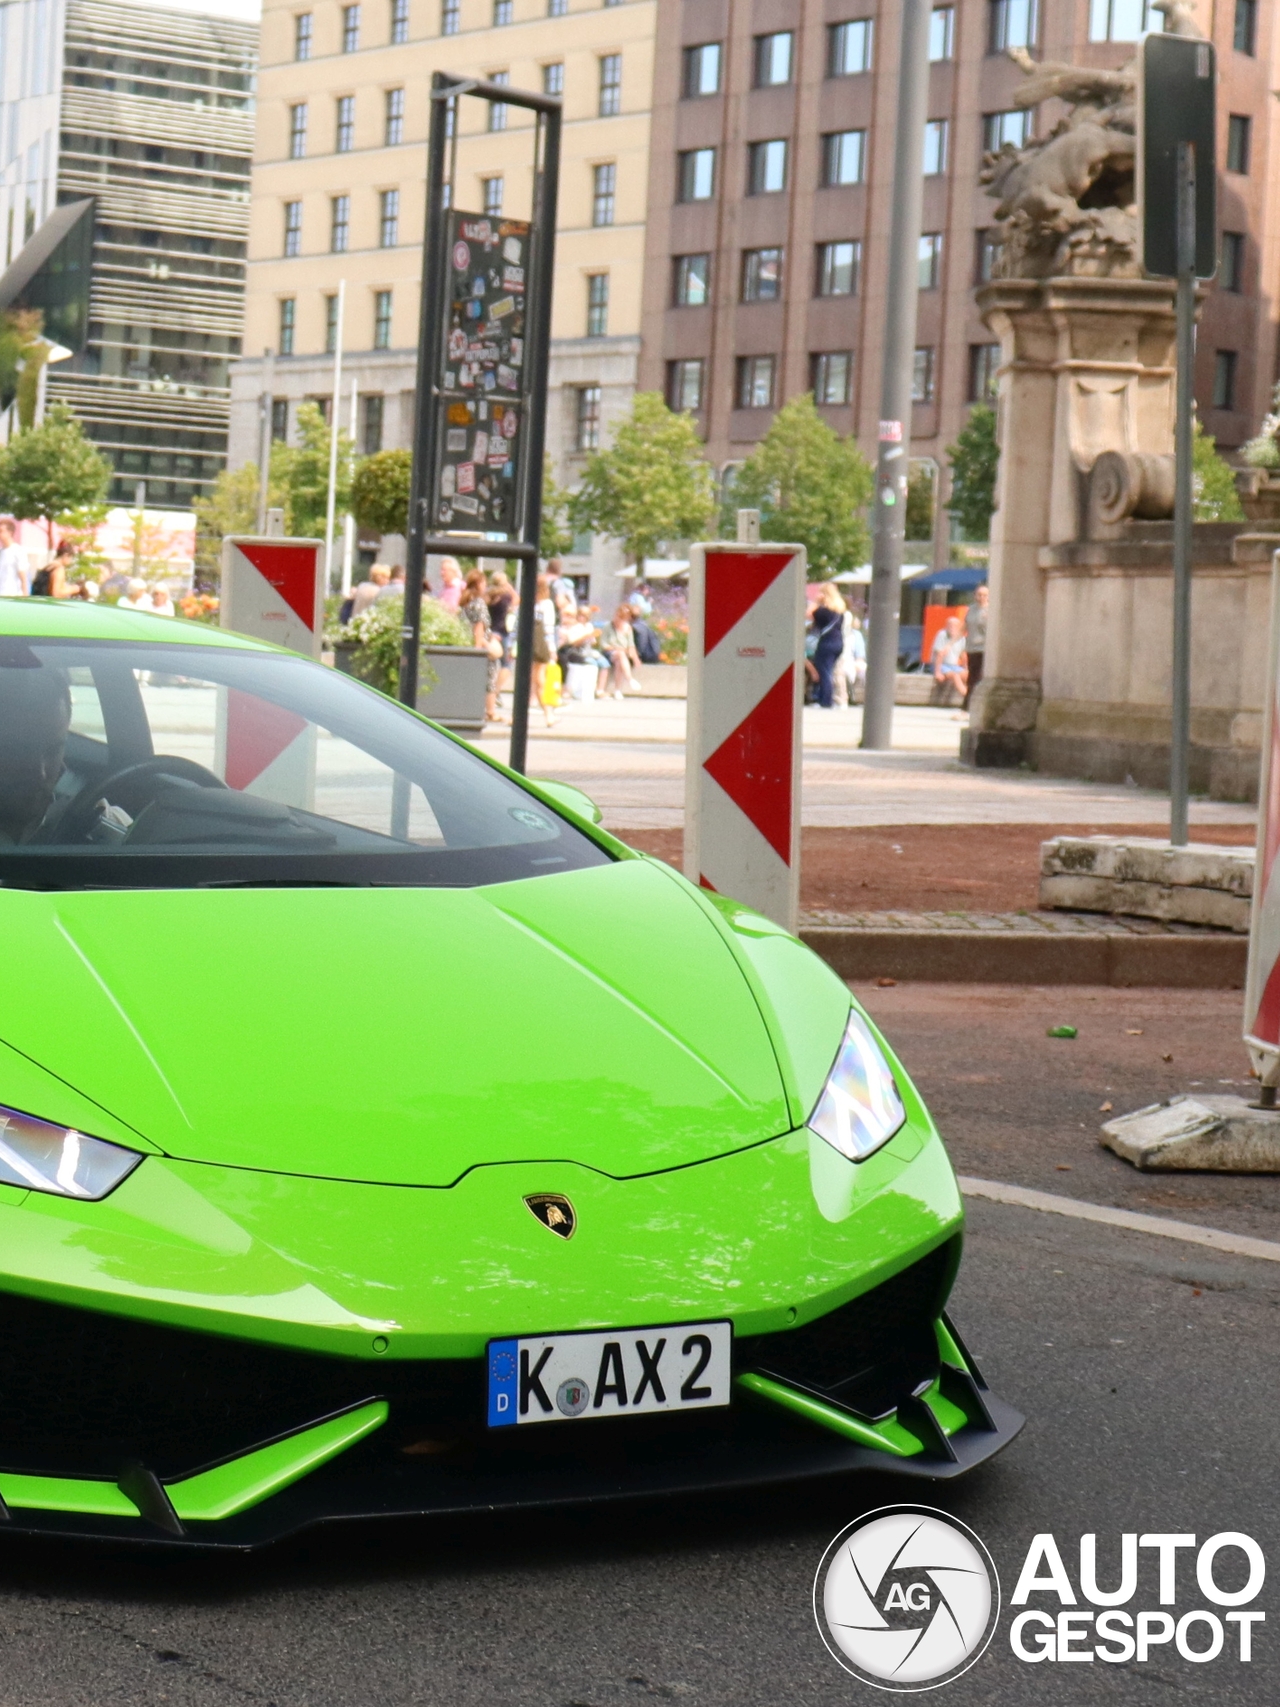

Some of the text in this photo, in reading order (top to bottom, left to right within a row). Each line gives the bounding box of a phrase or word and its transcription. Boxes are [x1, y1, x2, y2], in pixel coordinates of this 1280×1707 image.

[520, 1334, 712, 1415] K AX 2
[497, 1393, 509, 1412] D
